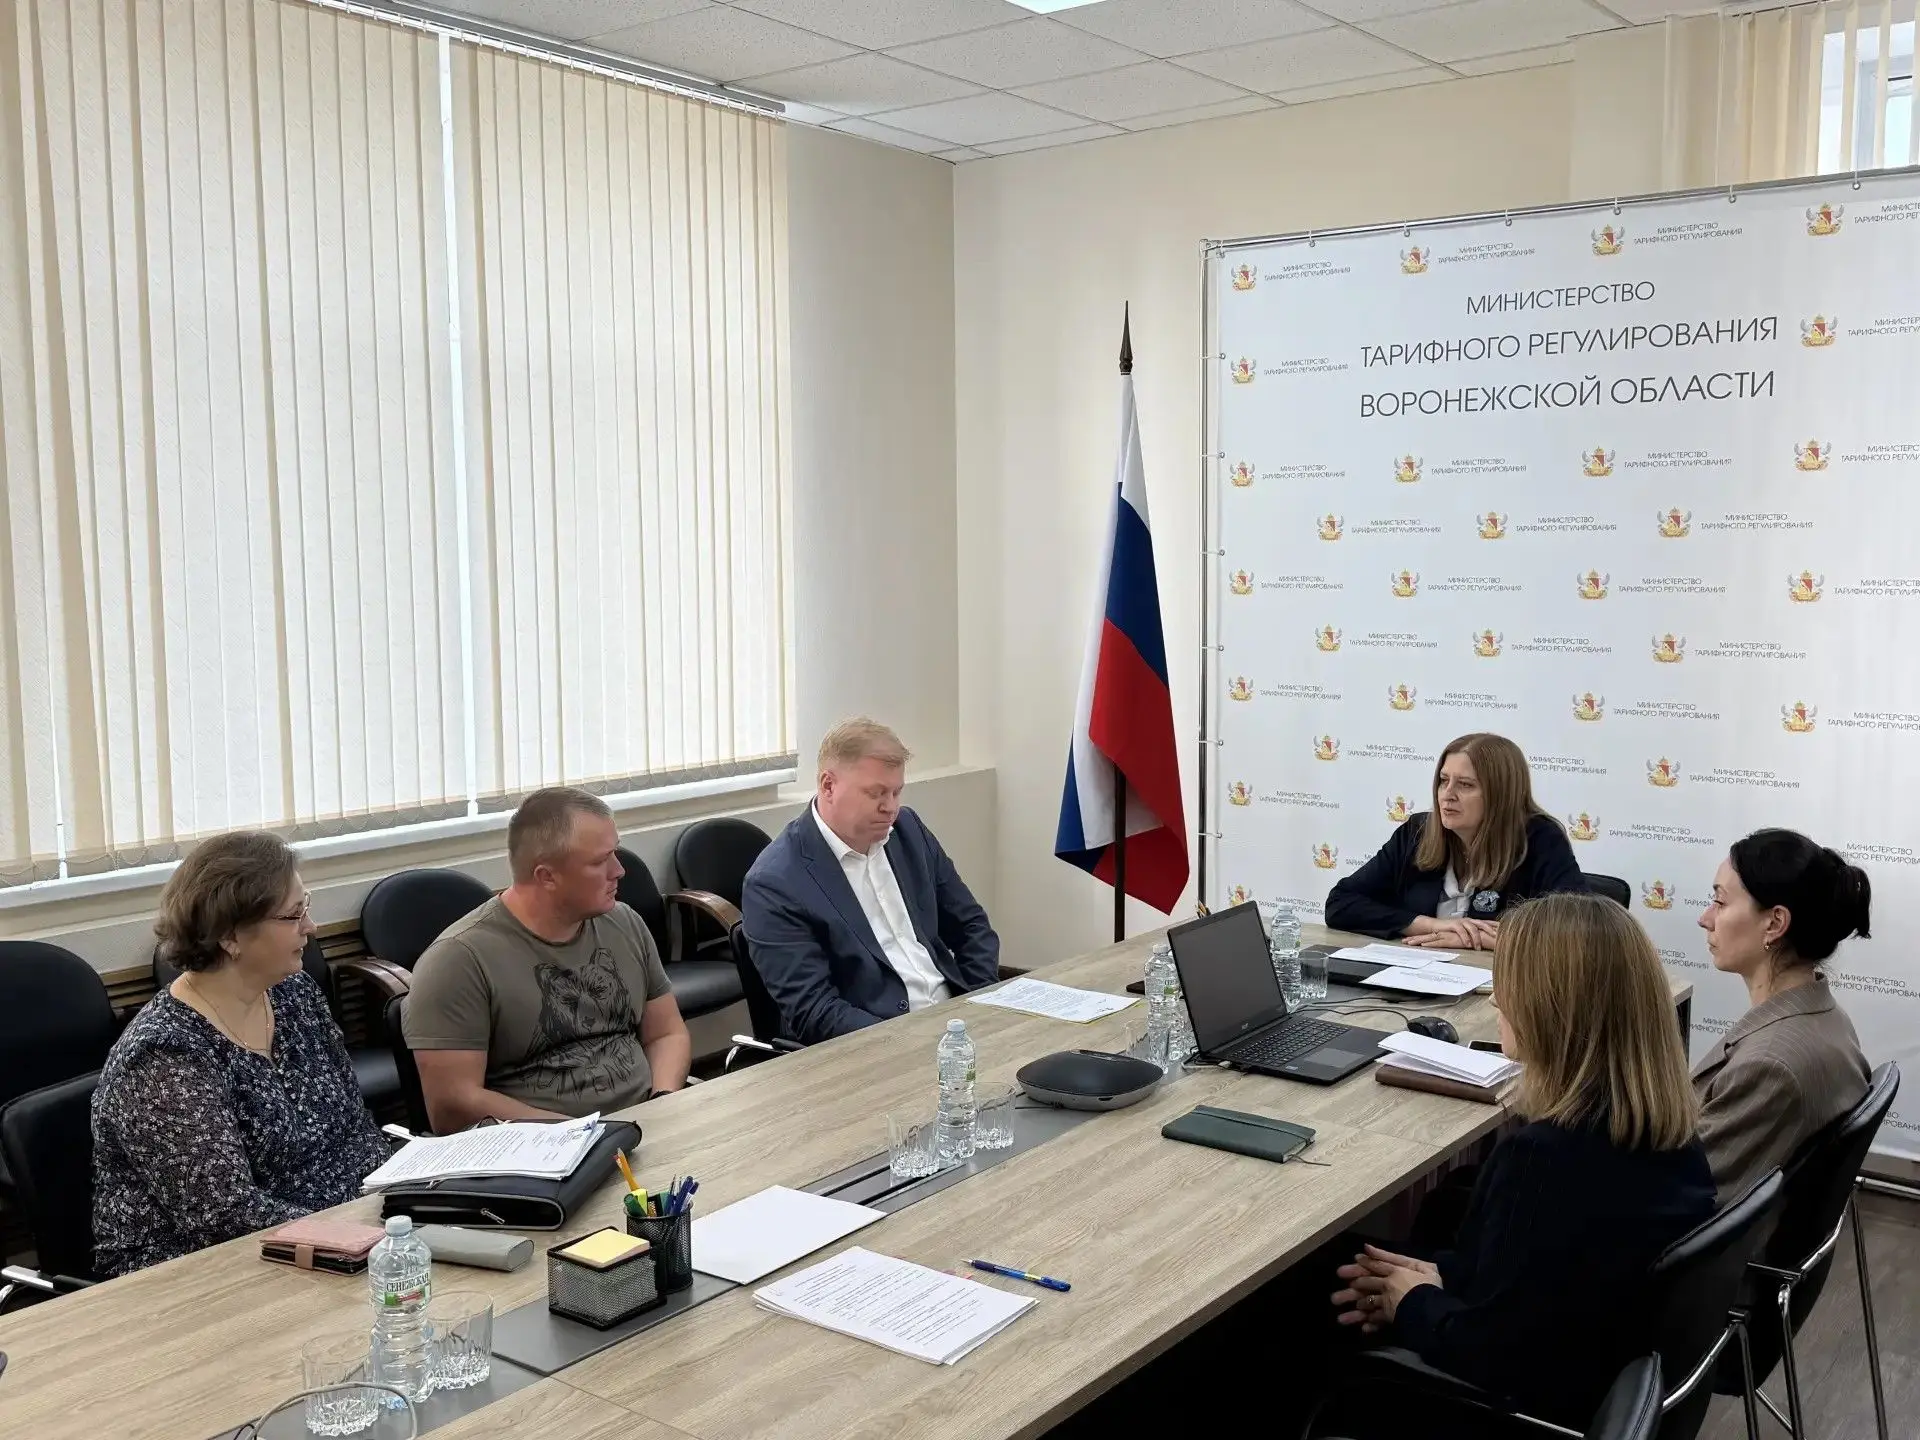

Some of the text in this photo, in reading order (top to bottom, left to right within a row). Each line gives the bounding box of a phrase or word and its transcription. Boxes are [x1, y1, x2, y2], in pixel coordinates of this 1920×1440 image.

[1465, 281, 1656, 315] МИНИСТЕРСТВО
[1361, 316, 1778, 368] ТАРИФНОГО РЕГУЛИРОВАНИЯ
[1360, 370, 1775, 418] ВОРОНЕЖСКОЙ ОБЛАСТИ
